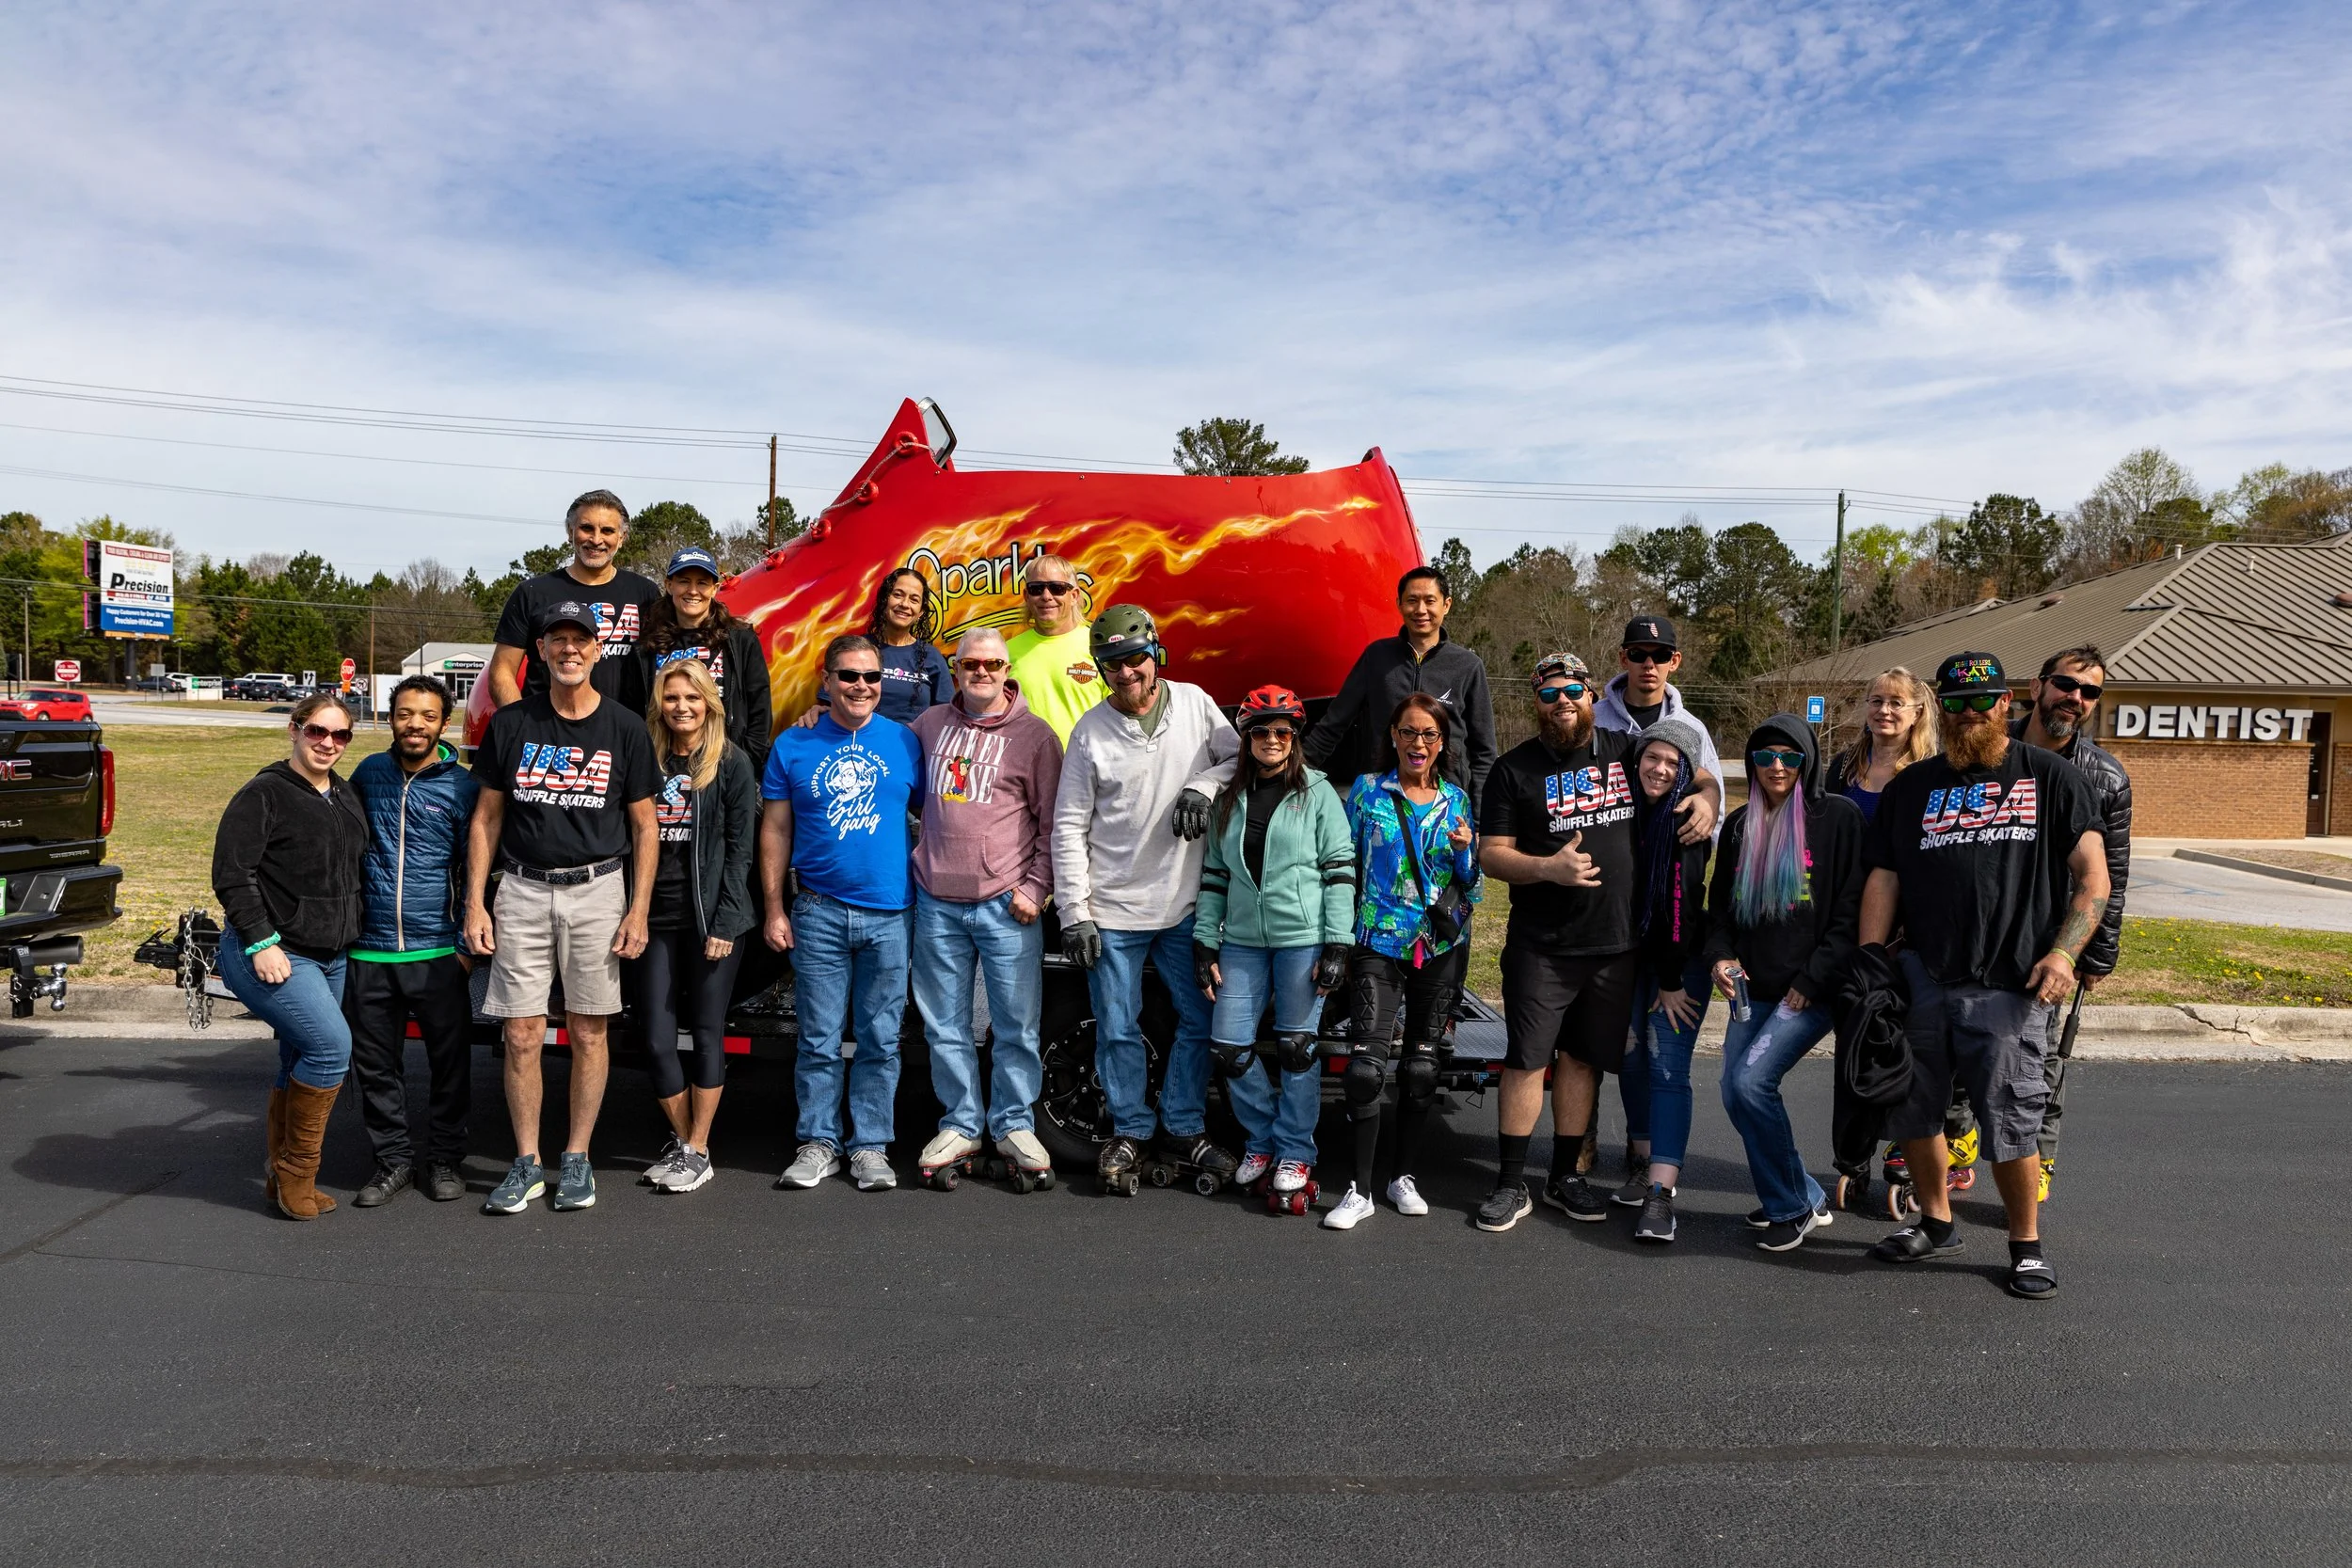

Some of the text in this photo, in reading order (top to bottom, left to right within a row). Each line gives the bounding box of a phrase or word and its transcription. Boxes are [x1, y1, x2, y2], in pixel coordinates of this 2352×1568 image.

[110, 572, 168, 594] Precision
[907, 543, 1094, 643] Sparks
[114, 617, 164, 627] Precision-HVAC.com
[582, 603, 640, 641] SA
[191, 678, 222, 688] enterprise
[341, 665, 355, 674] STOP
[882, 668, 930, 684] BOLIX
[1948, 666, 1997, 677] SKATE
[2116, 705, 2313, 741] DENTIST
[931, 725, 1012, 766] MICKEY
[516, 742, 612, 794] USA
[811, 744, 890, 798] SUPPORT YOUR LOCAL
[929, 755, 998, 804] MOSE
[513, 787, 606, 809] SHUFFLE SKATERS
[1546, 762, 1633, 816] USA
[827, 792, 876, 827] Girl
[1549, 806, 1635, 832] SHUFFLE SKATERS
[1922, 778, 2036, 832] USA
[838, 813, 882, 840] gang
[1920, 827, 2037, 850] SHUFFLE SKATERS
[1673, 862, 1682, 942] PALM BEACH
[2020, 1259, 2043, 1268] NIKE
